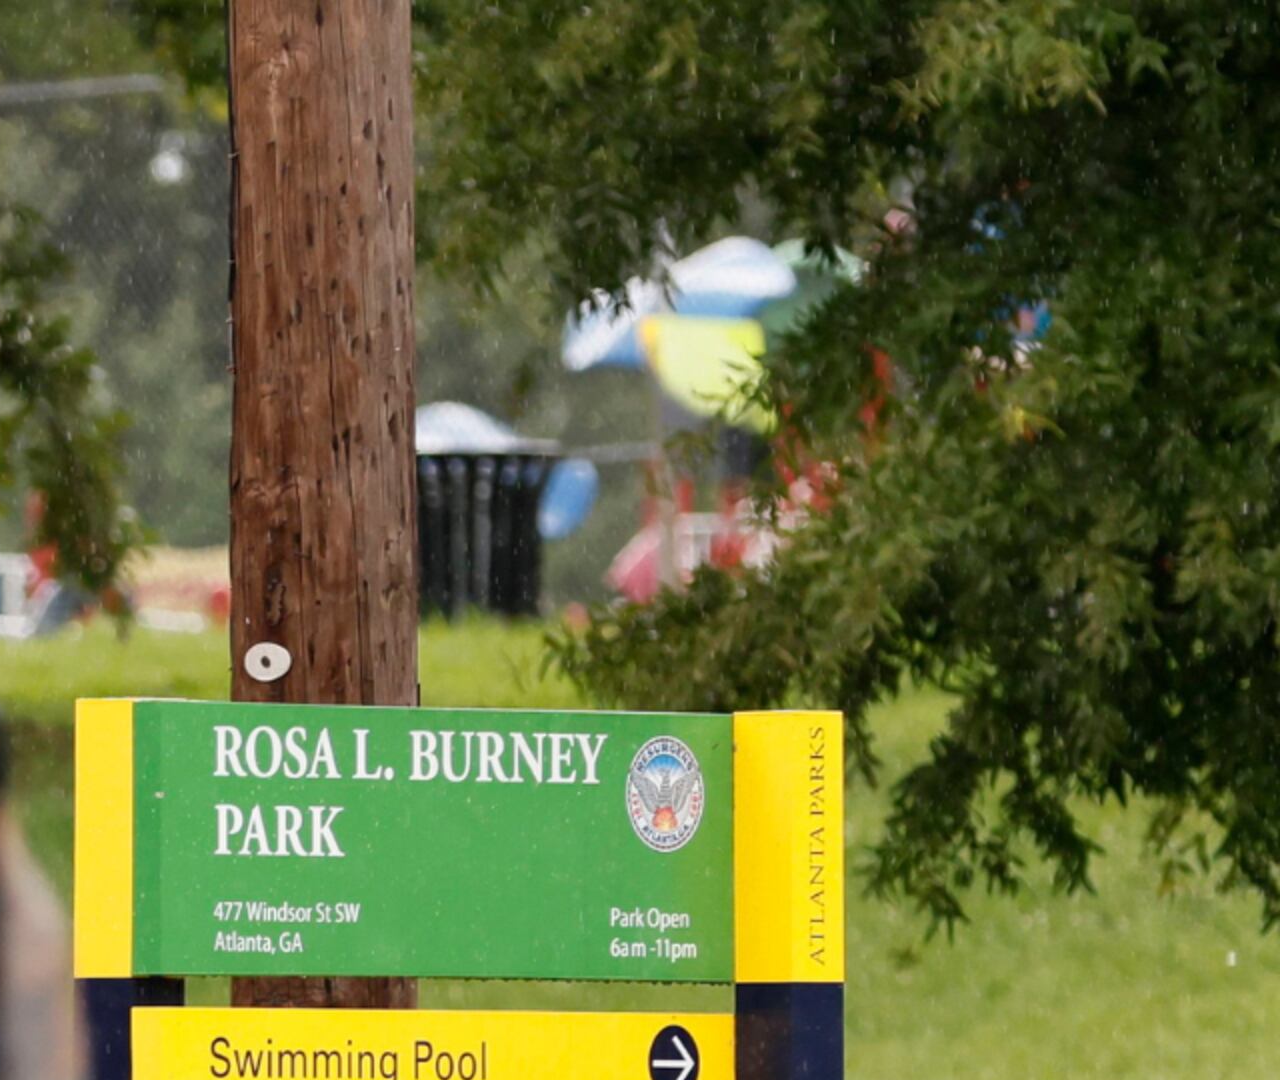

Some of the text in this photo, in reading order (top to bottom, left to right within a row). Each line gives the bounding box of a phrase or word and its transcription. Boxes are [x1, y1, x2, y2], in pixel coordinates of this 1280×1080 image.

[212, 724, 609, 785] ROSA L. BURNEY
[213, 803, 346, 858] PARK
[808, 725, 826, 966] ATLANTA PARKS
[212, 900, 361, 924] 477 Windsor St SW
[610, 906, 691, 933] Park Open
[213, 930, 304, 955] Atlanta, GA
[609, 937, 647, 958] 6am
